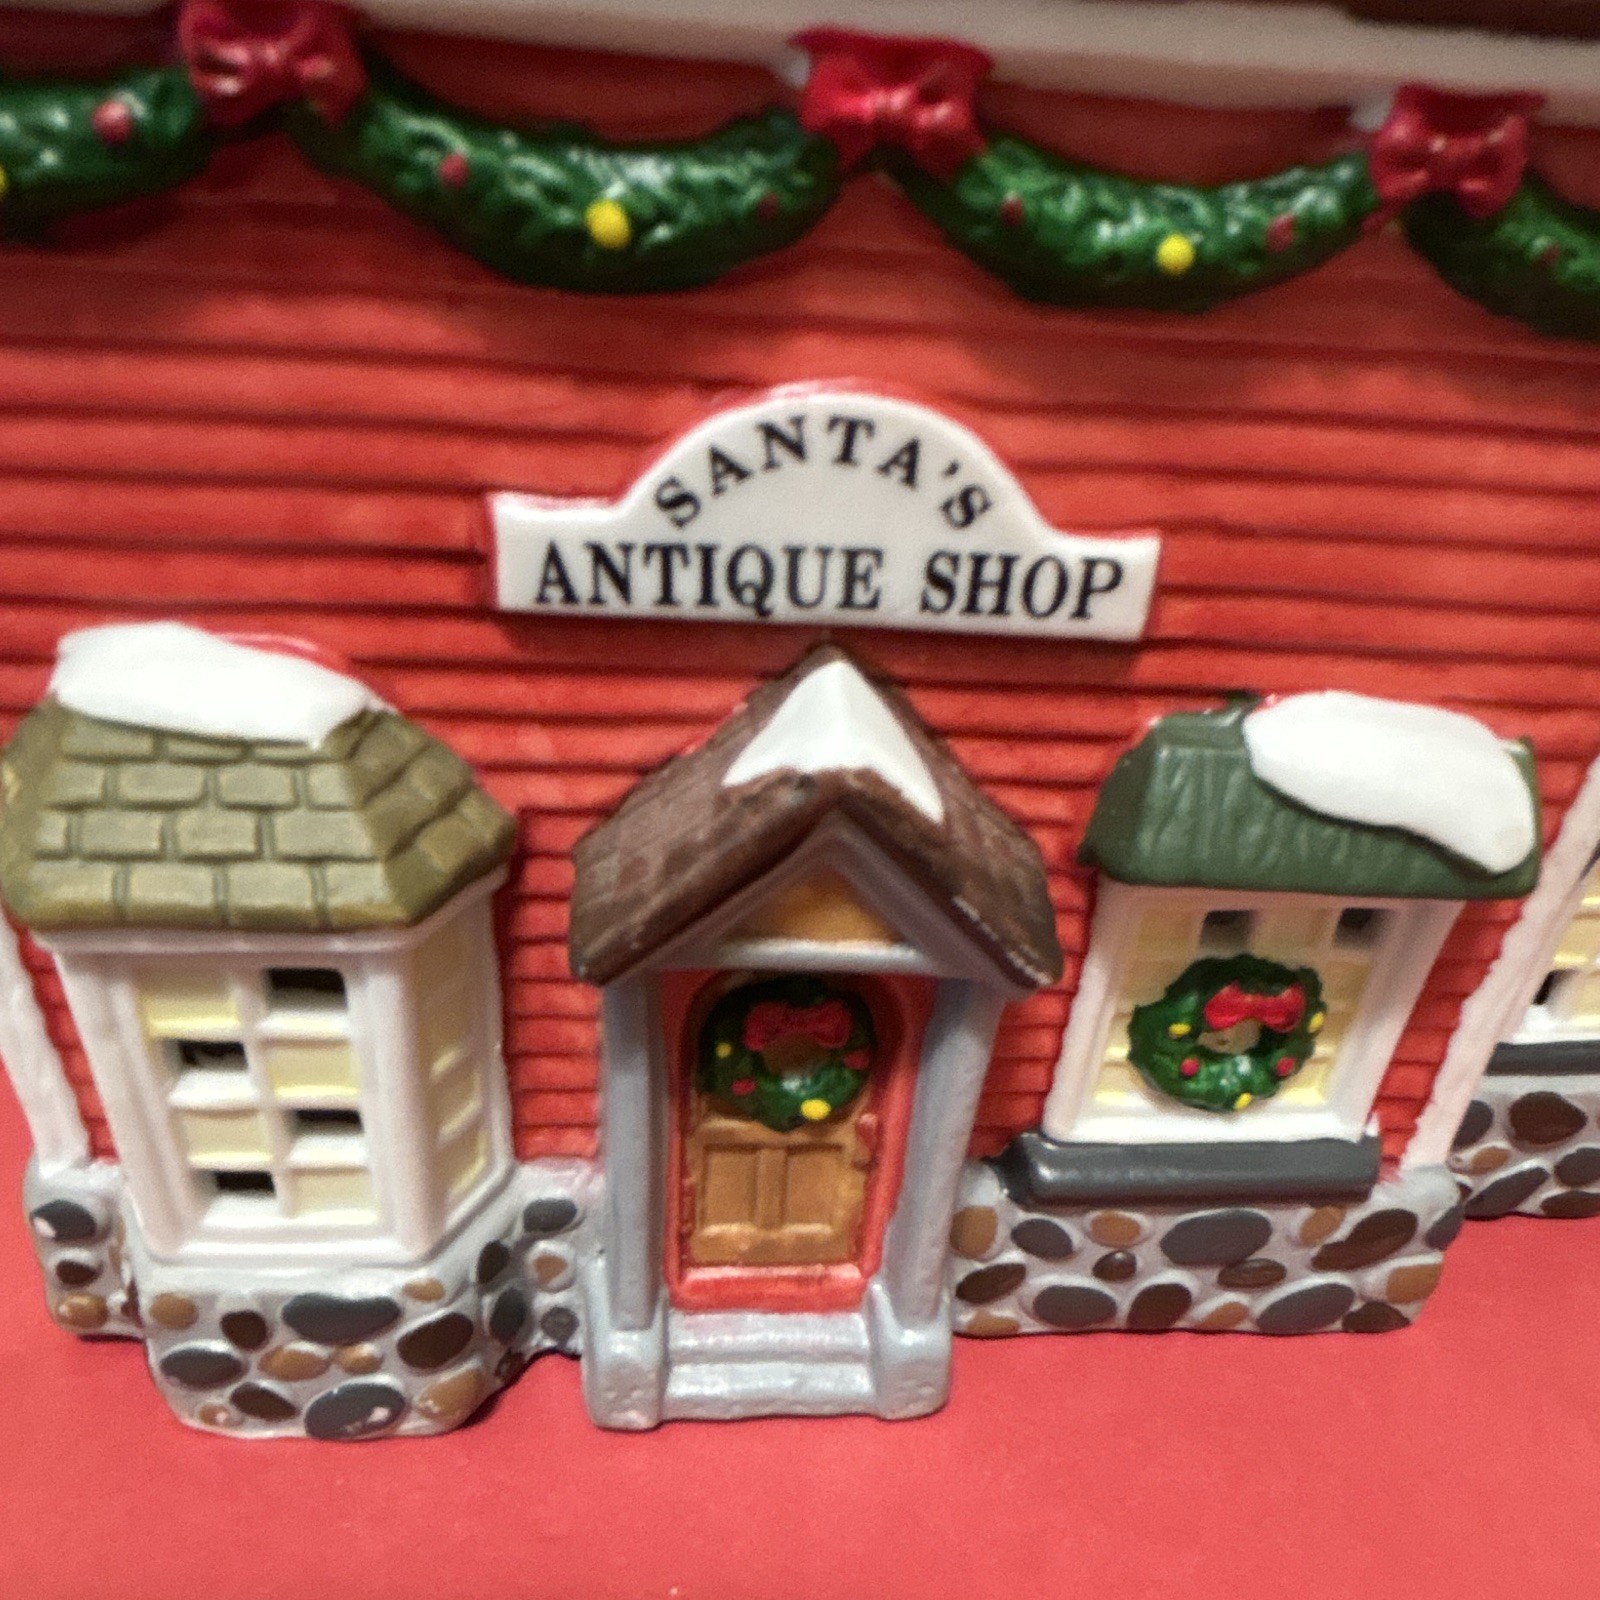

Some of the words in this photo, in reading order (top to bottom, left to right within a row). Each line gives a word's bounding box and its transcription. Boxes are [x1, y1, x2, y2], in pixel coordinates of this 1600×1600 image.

[654, 414, 992, 530] SANTA'S
[535, 541, 884, 617] ANTIQUE
[919, 549, 1125, 621] SHOP
